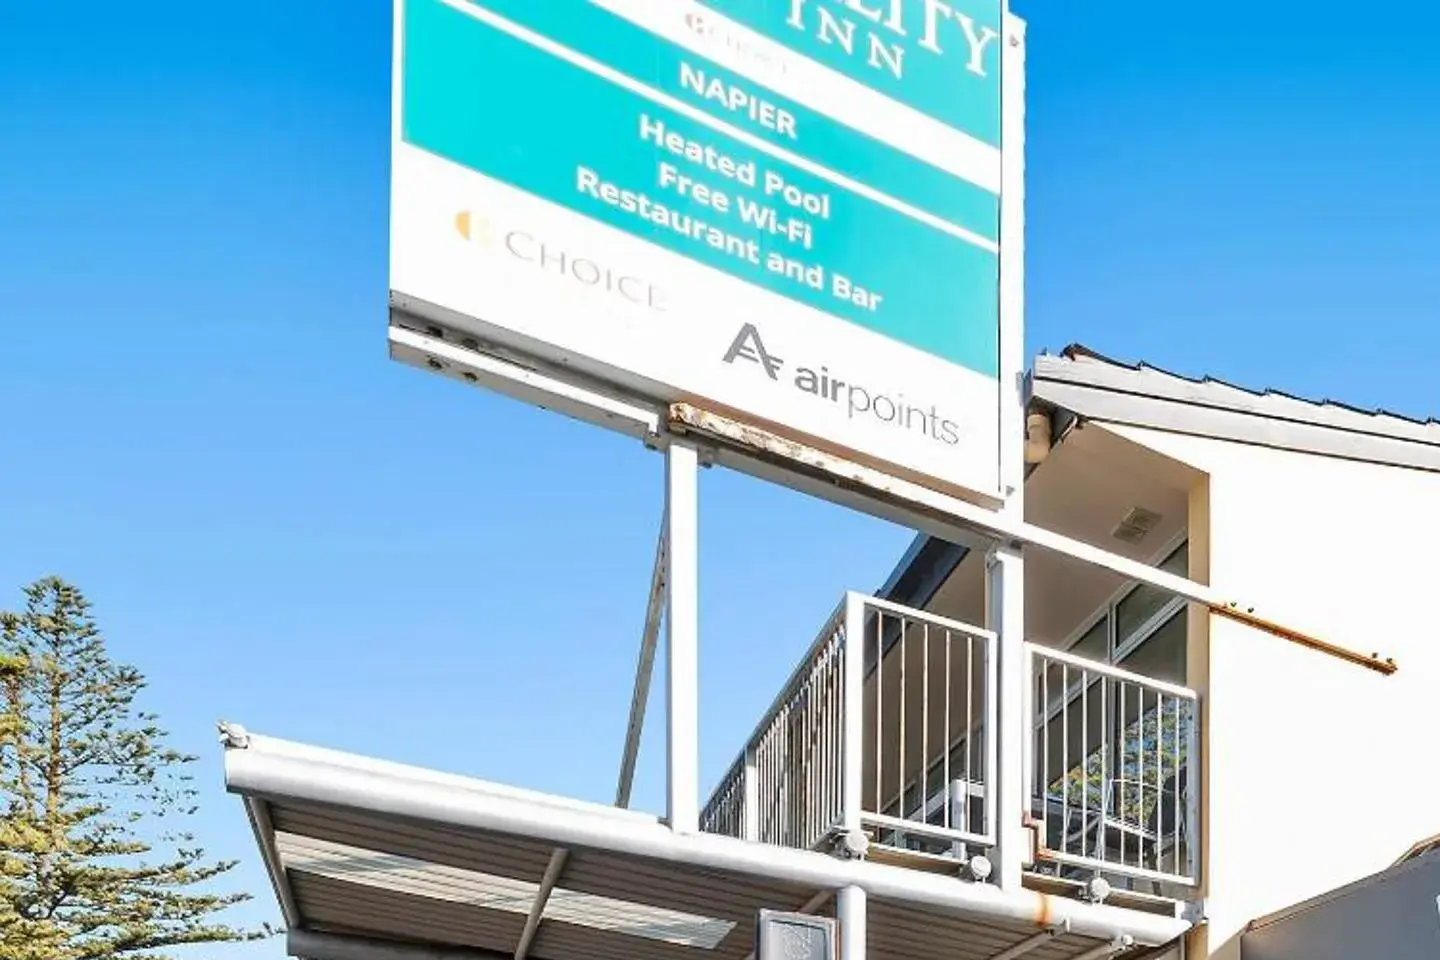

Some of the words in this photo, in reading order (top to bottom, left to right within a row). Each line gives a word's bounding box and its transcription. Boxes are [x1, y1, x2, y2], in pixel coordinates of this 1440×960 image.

[786, 0, 905, 80] INN
[680, 61, 797, 139] NAPIER
[639, 113, 755, 187] Heated
[764, 170, 830, 220] Pool
[659, 162, 729, 212] Free
[737, 195, 812, 249] Wi-Fi
[505, 230, 667, 312] CHOICE
[576, 166, 759, 264] Restaurant
[767, 252, 823, 290] and
[833, 273, 883, 312] Bar
[795, 366, 959, 445] airpoints
